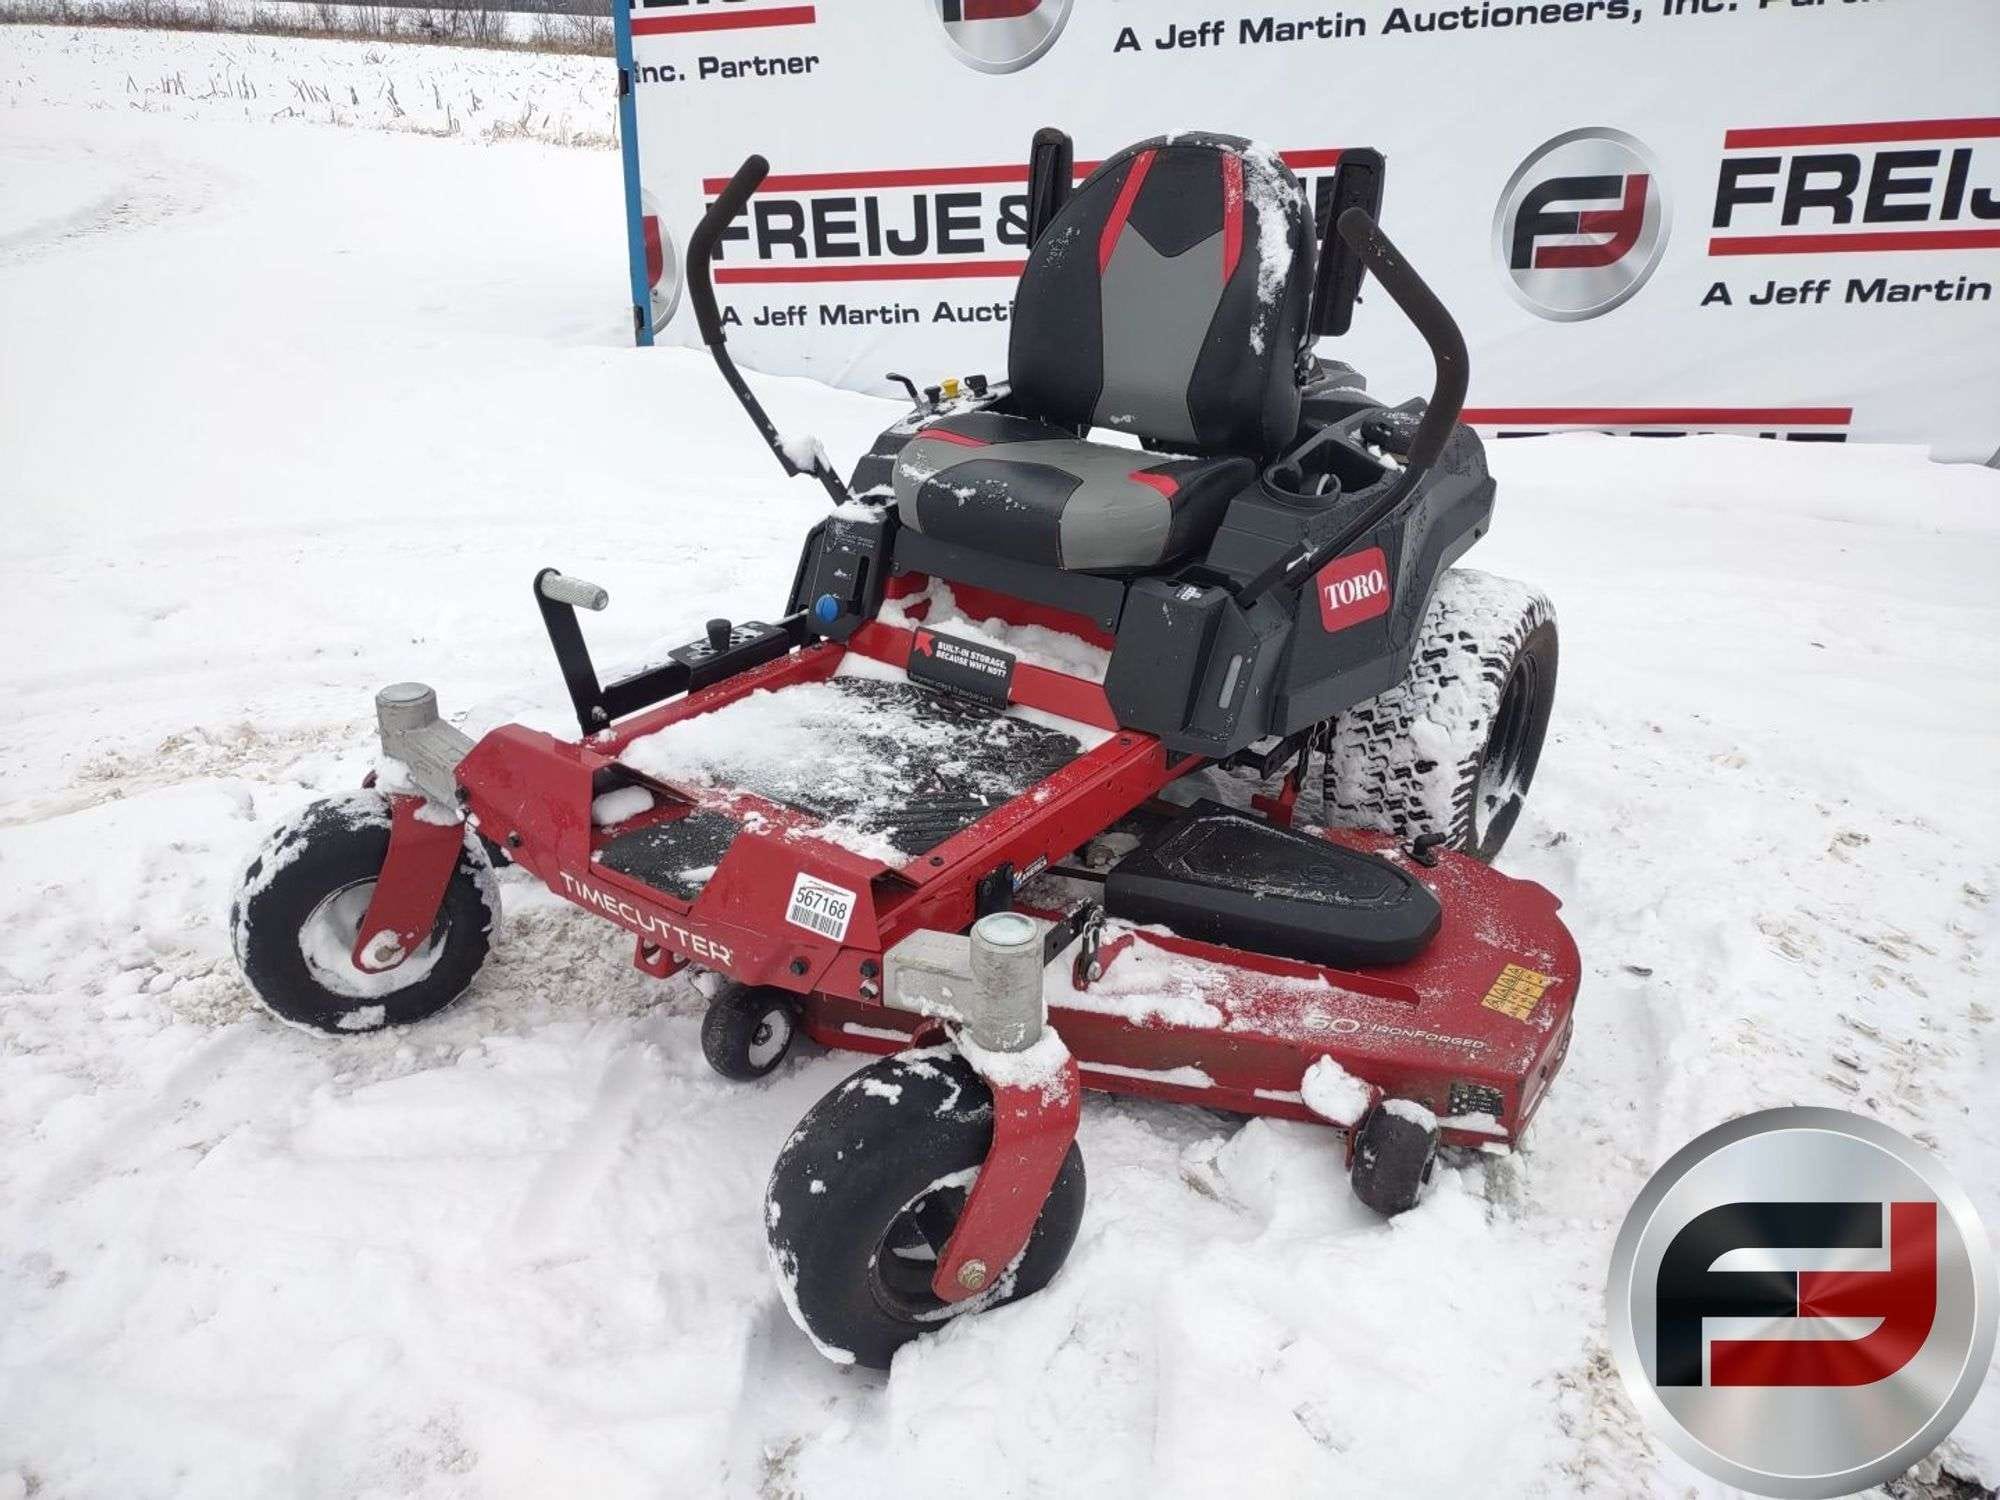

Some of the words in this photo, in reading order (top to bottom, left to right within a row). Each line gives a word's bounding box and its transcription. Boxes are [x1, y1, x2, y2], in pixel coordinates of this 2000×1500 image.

[1113, 27, 1141, 52] A
[1155, 20, 1225, 50] Jeff
[1239, 12, 1366, 44] Martin
[1381, 0, 1642, 34] Auctioneers,
[698, 55, 819, 80] Partner
[1700, 281, 1732, 306] A
[1750, 279, 1831, 306] Jeff
[1844, 277, 1992, 304] Martin
[721, 305, 742, 326] A
[753, 305, 807, 326] Jeff
[819, 303, 919, 325] Martin
[1324, 569, 1384, 610] TORO
[935, 649, 968, 666] BECAUSE
[968, 659, 987, 672] WHY
[559, 871, 732, 967] TIMECUTTER
[796, 887, 847, 920] 567168
